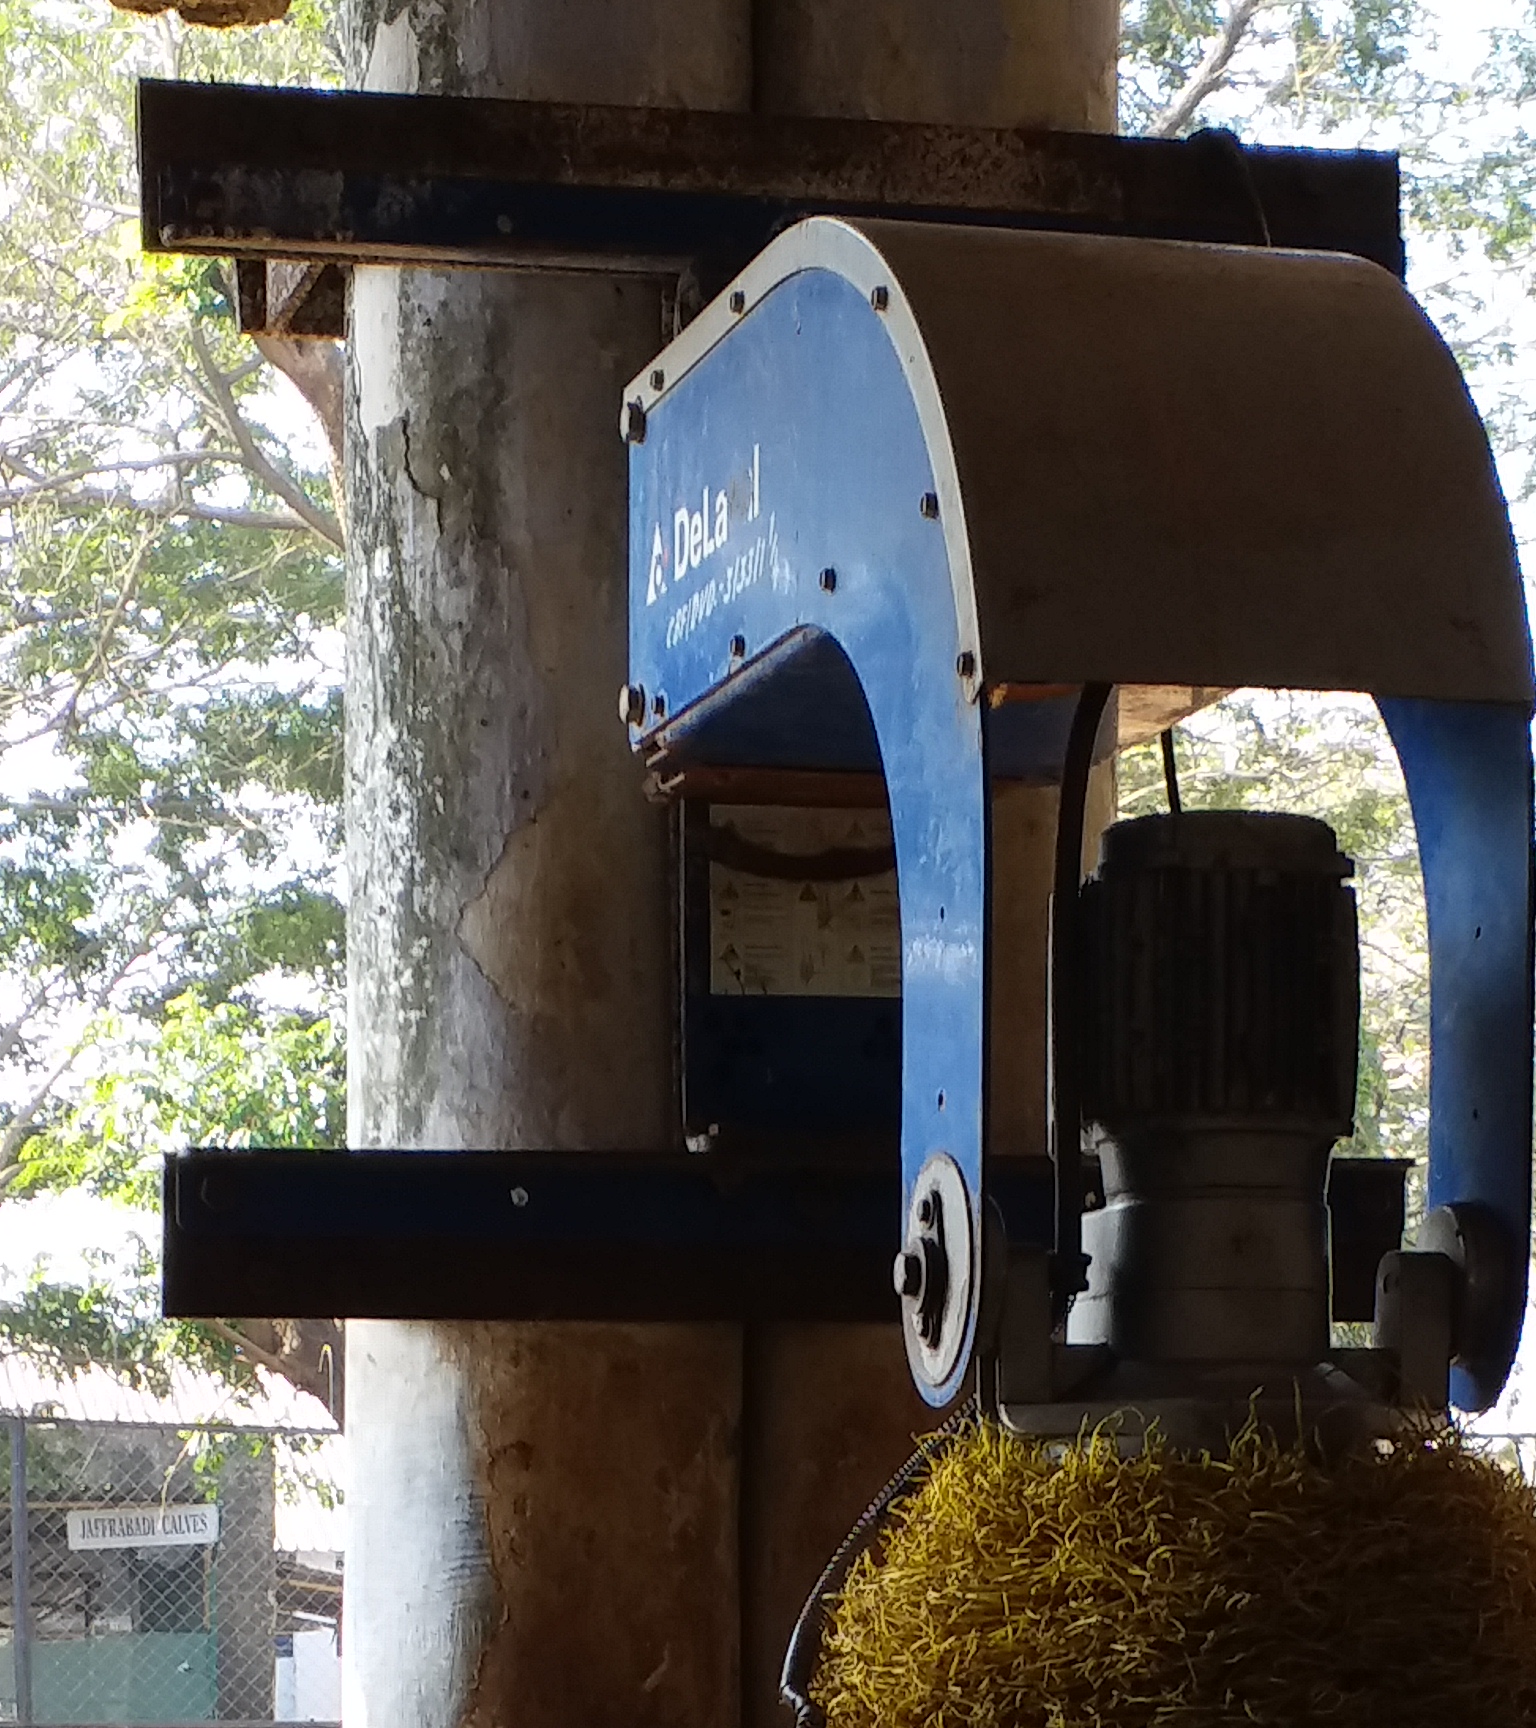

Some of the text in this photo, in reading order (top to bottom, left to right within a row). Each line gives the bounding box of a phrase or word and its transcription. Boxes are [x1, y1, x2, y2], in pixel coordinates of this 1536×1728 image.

[673, 442, 760, 581] DeLal
[80, 1512, 208, 1539] JAFFRABADI CALVES
